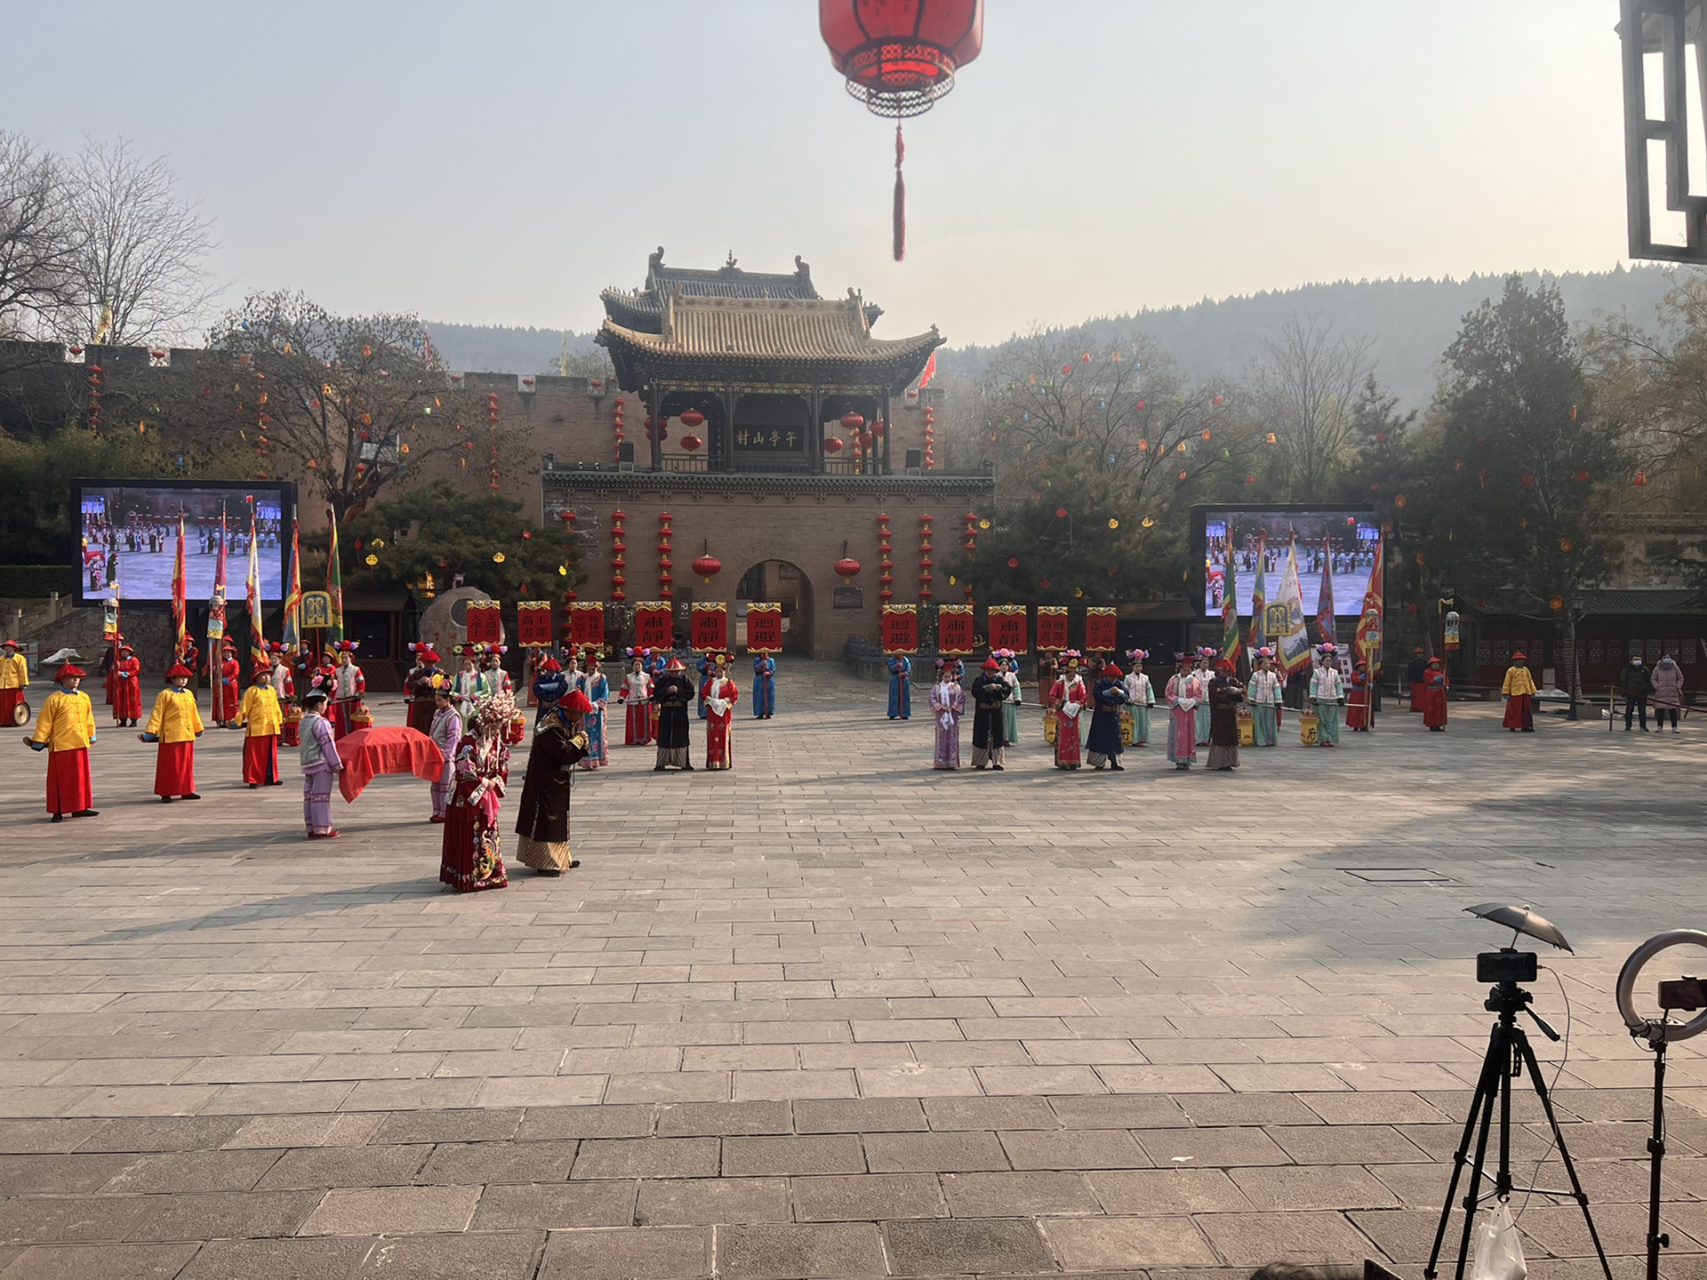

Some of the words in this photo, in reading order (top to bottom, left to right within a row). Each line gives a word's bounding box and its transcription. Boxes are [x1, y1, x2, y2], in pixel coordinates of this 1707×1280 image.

[521, 615, 534, 638] 尚書
[536, 615, 549, 638] 工部
[1041, 619, 1053, 642] 尚書
[1053, 620, 1065, 642] 刑部
[1102, 620, 1114, 643] 正一品
[1306, 727, 1317, 741] 府
